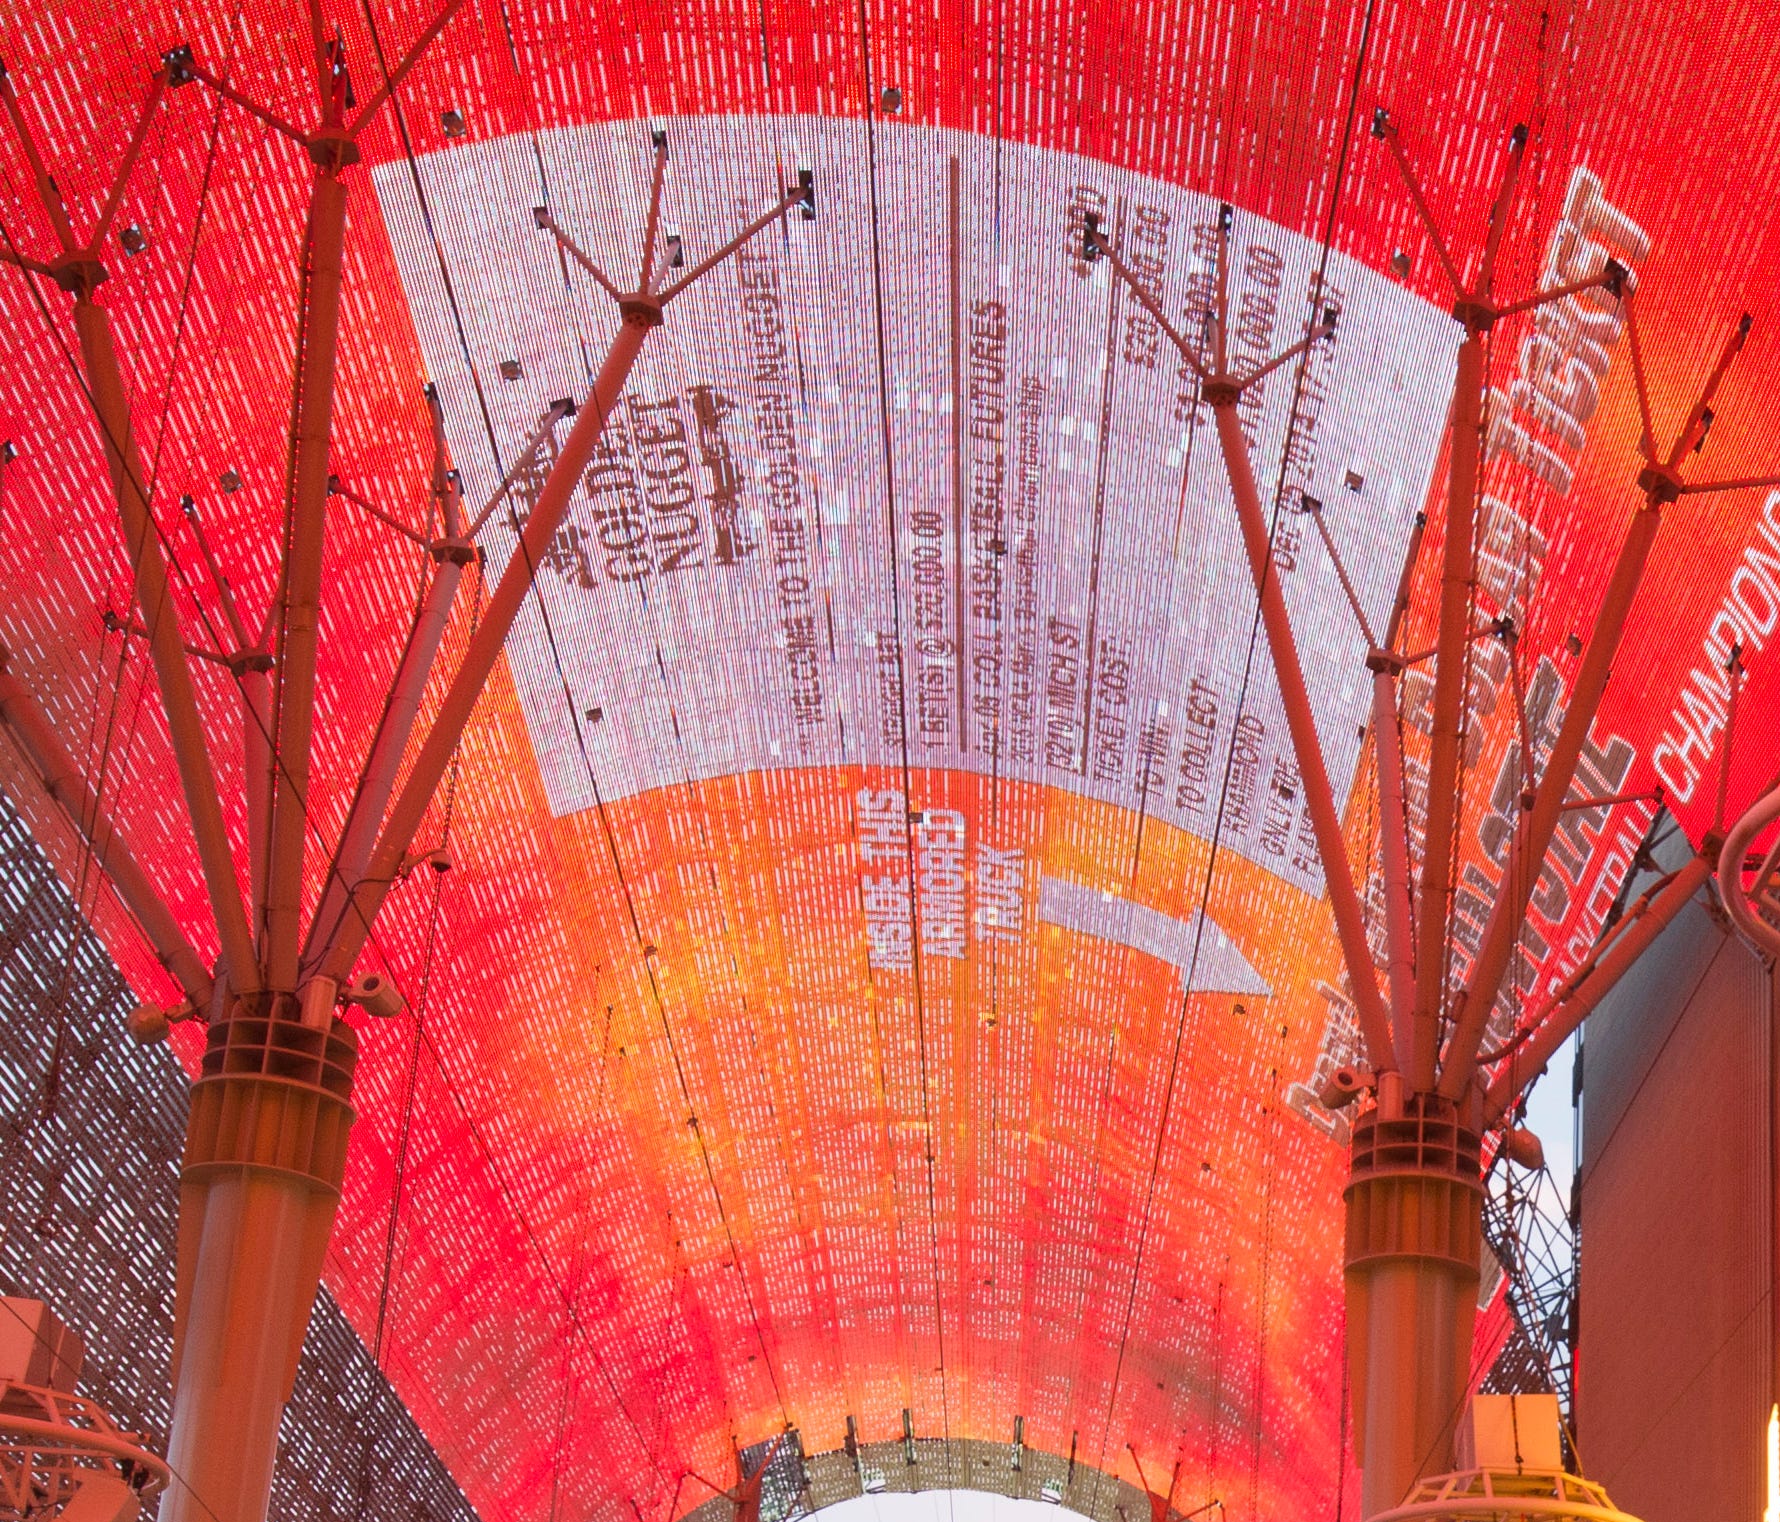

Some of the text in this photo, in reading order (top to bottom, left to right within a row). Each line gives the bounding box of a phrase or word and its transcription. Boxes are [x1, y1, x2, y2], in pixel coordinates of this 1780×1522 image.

[970, 299, 1006, 443] FUTURES
[1486, 165, 1652, 496] TICKET
[625, 393, 704, 573] NUGGET
[738, 250, 824, 725] WELCOME TO THE GOLDEN NUGGET
[971, 452, 1005, 621] BASKETBALL
[1048, 618, 1079, 710] MICH ST
[1094, 715, 1125, 784] TICKET
[1142, 762, 1166, 796] TO
[1175, 782, 1205, 814] TO
[859, 786, 914, 972] INSIDE THIS
[919, 805, 970, 962] ARMORED
[975, 843, 1026, 943] TRUCK
